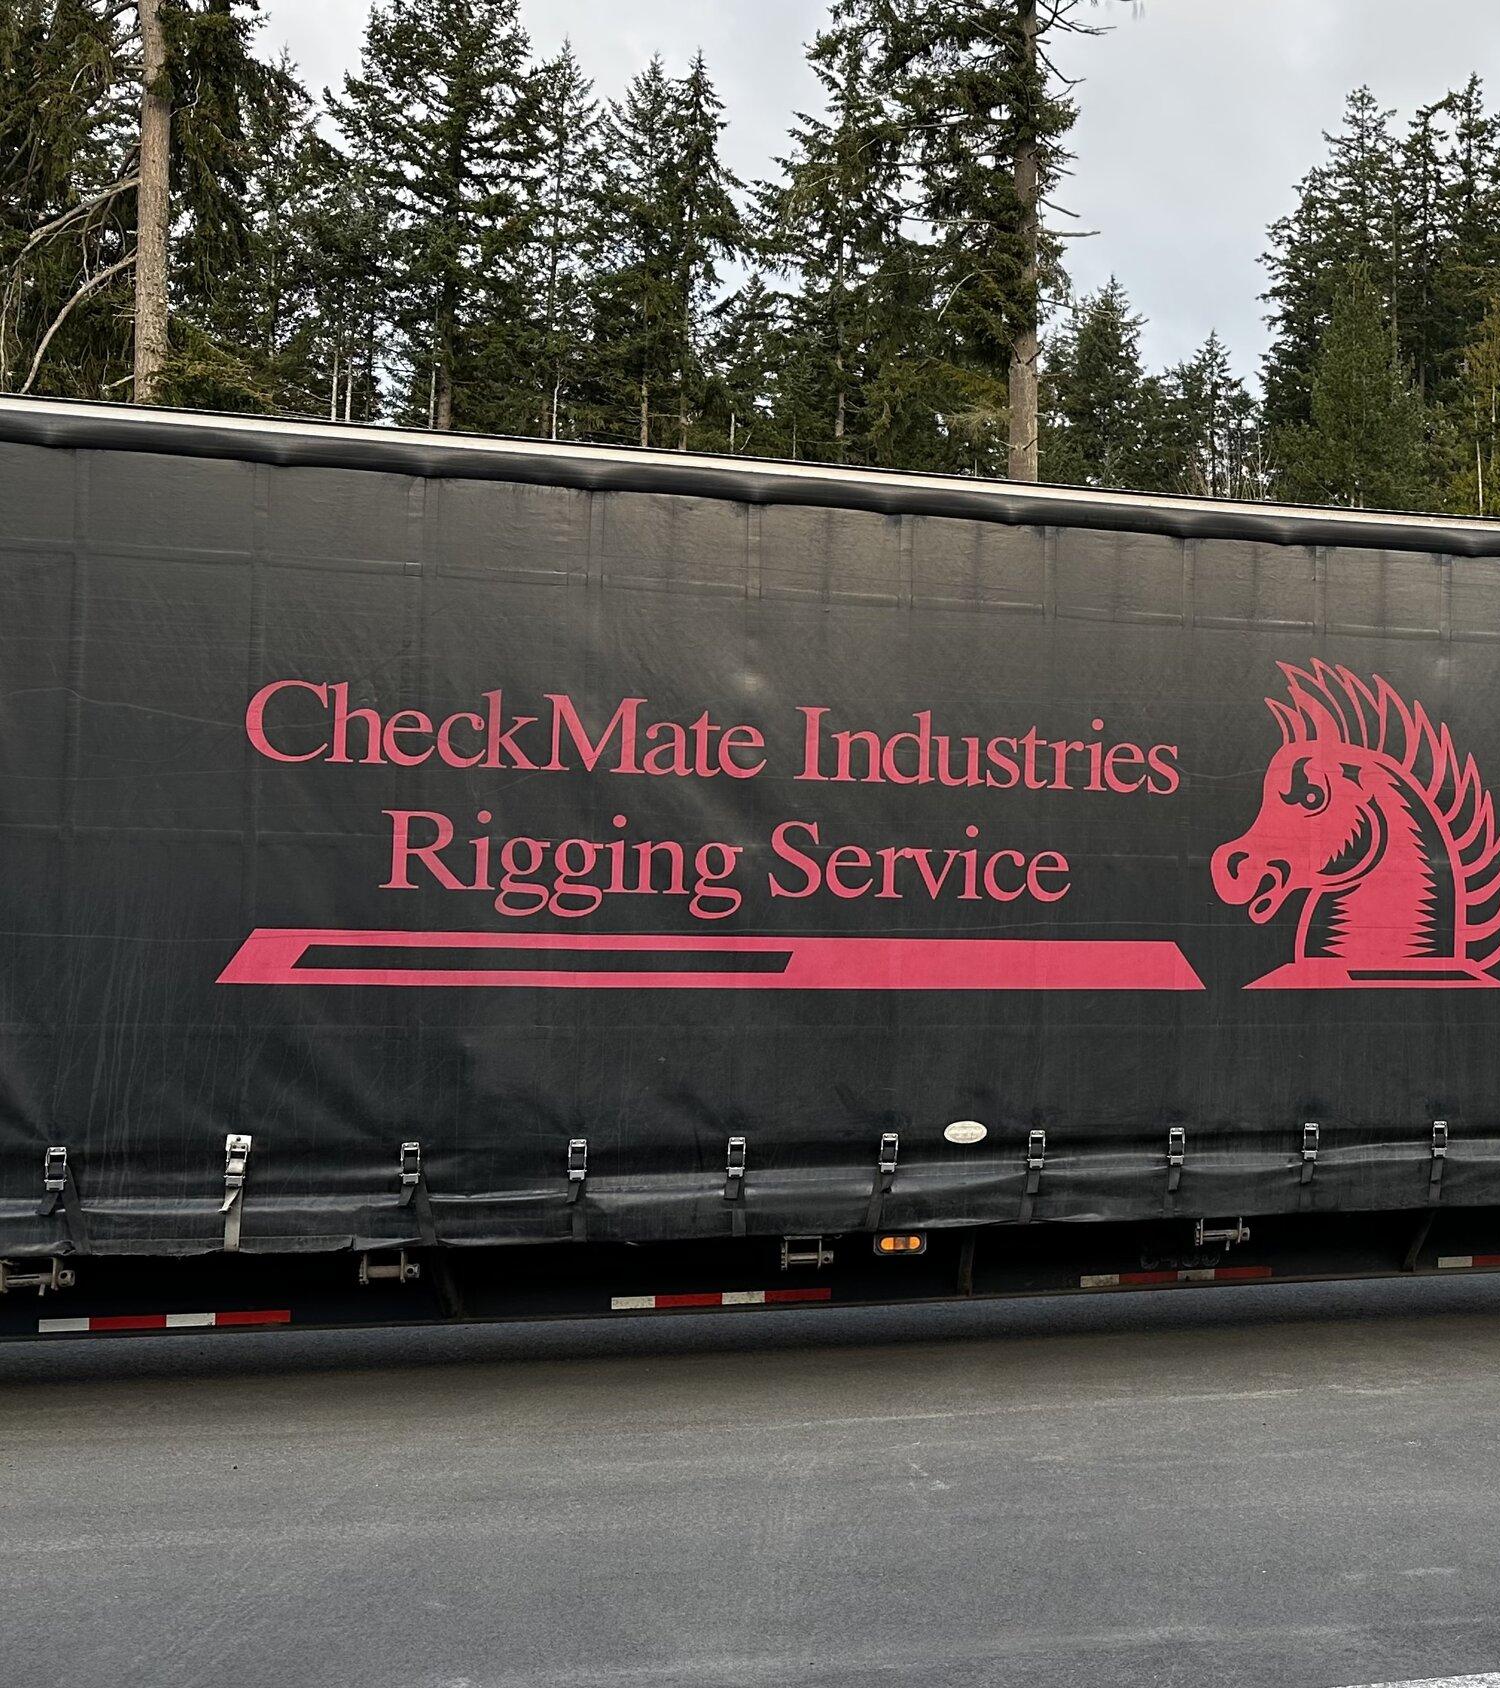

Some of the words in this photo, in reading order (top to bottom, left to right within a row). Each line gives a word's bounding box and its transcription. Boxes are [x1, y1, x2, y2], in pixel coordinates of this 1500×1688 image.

[245, 679, 766, 779] CheckMate
[796, 706, 1181, 795] Industries
[379, 809, 743, 919] Rigging
[768, 821, 1071, 903] Service
